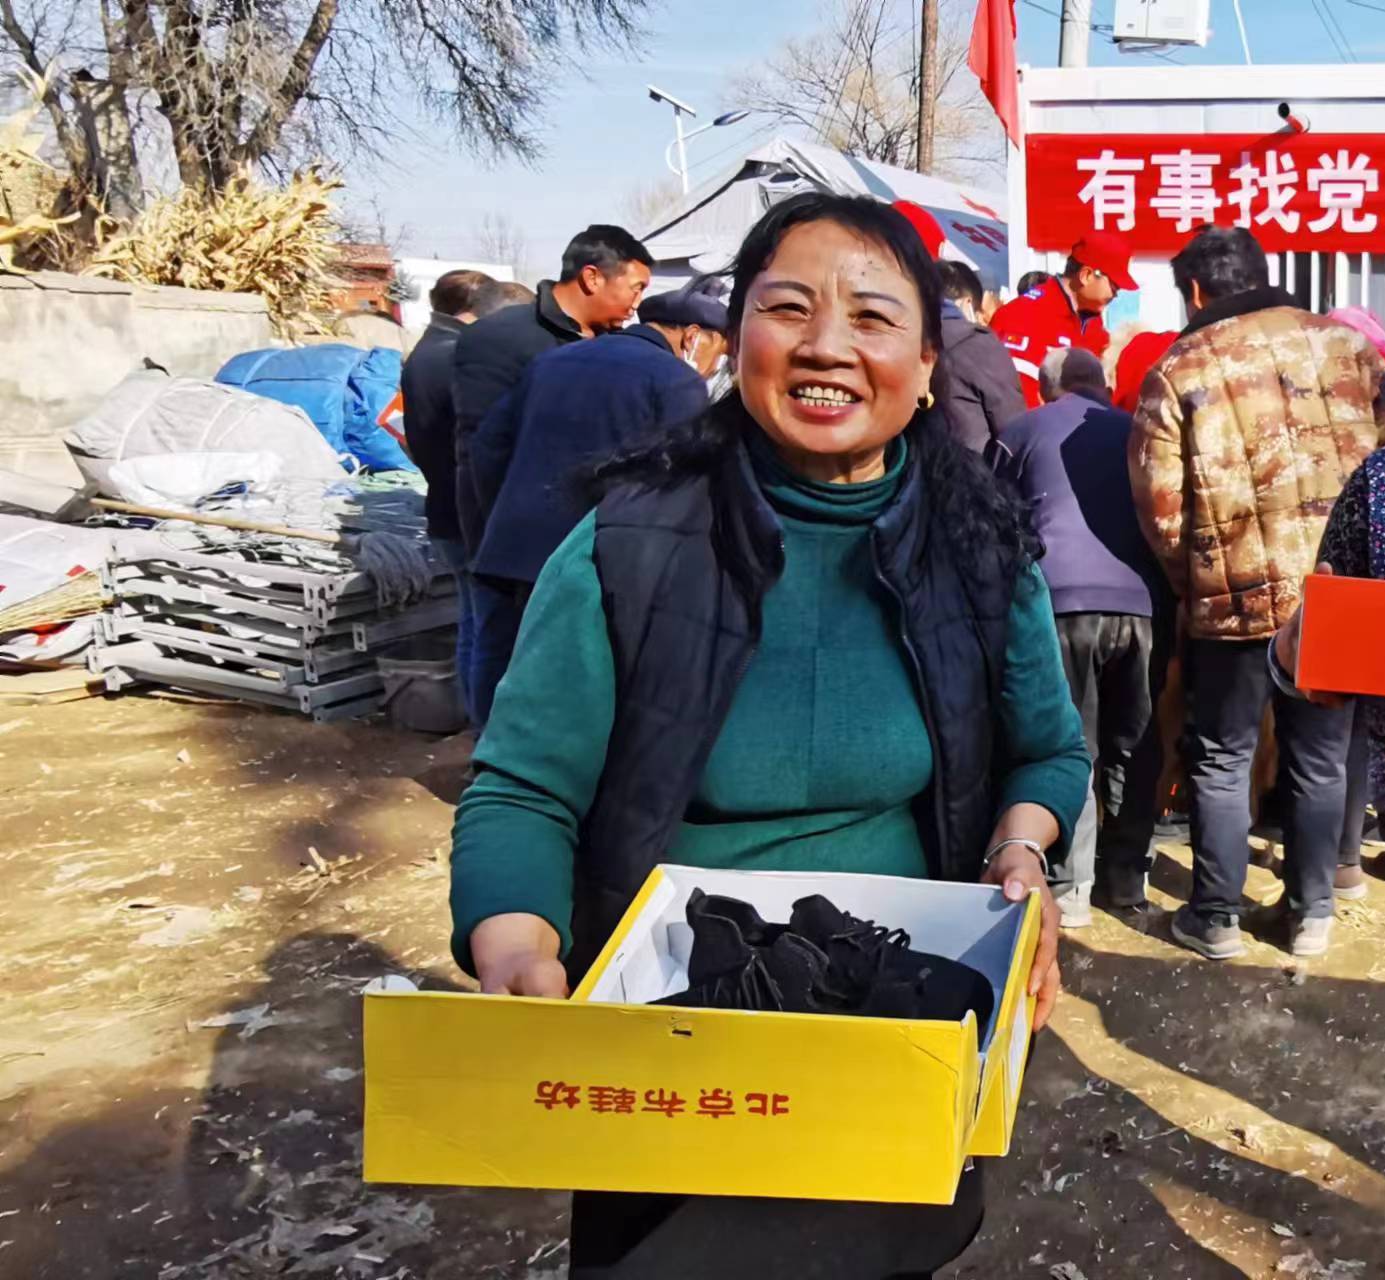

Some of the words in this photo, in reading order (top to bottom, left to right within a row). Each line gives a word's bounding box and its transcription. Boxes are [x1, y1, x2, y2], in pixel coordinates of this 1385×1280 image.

[534, 1080, 790, 1118] 北京布鞋坊
